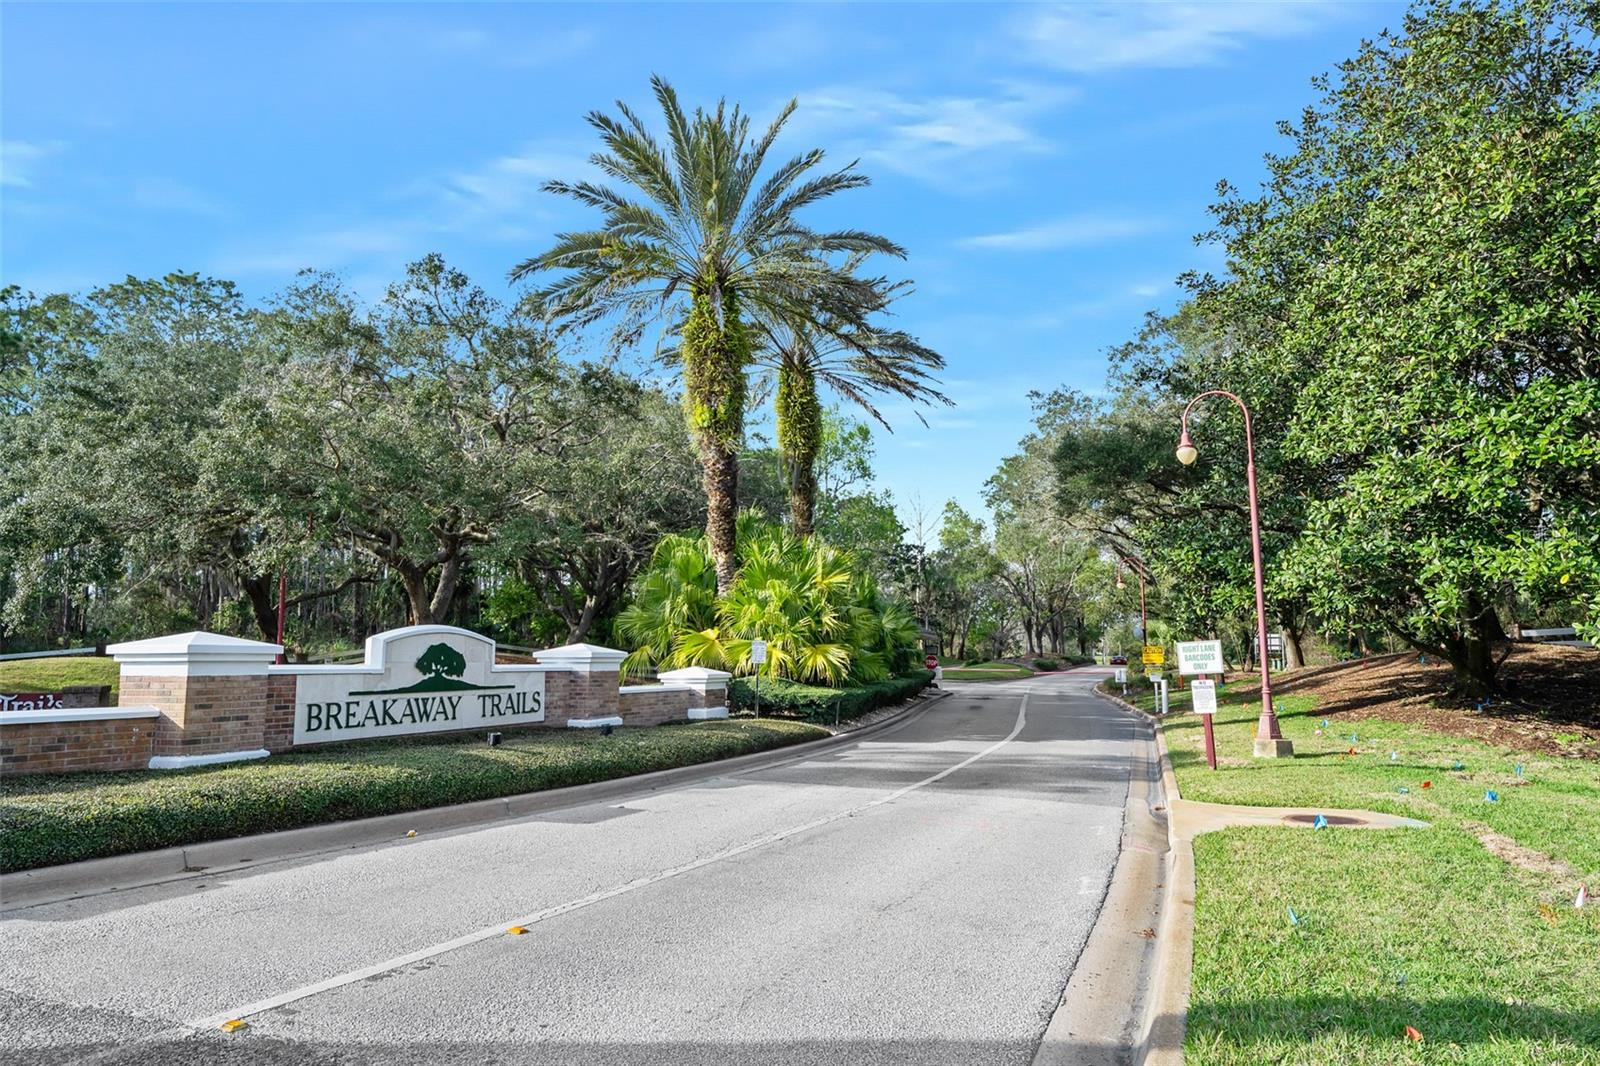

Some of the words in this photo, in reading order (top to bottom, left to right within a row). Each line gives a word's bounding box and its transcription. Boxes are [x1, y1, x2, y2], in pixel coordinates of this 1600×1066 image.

[1182, 645, 1199, 653] RIGHT
[1200, 644, 1216, 652] LANE
[1185, 653, 1216, 662] BARCODES
[1193, 662, 1208, 670] ONLY
[306, 696, 462, 732] BREAKAWAY
[478, 691, 541, 718] TRAILS
